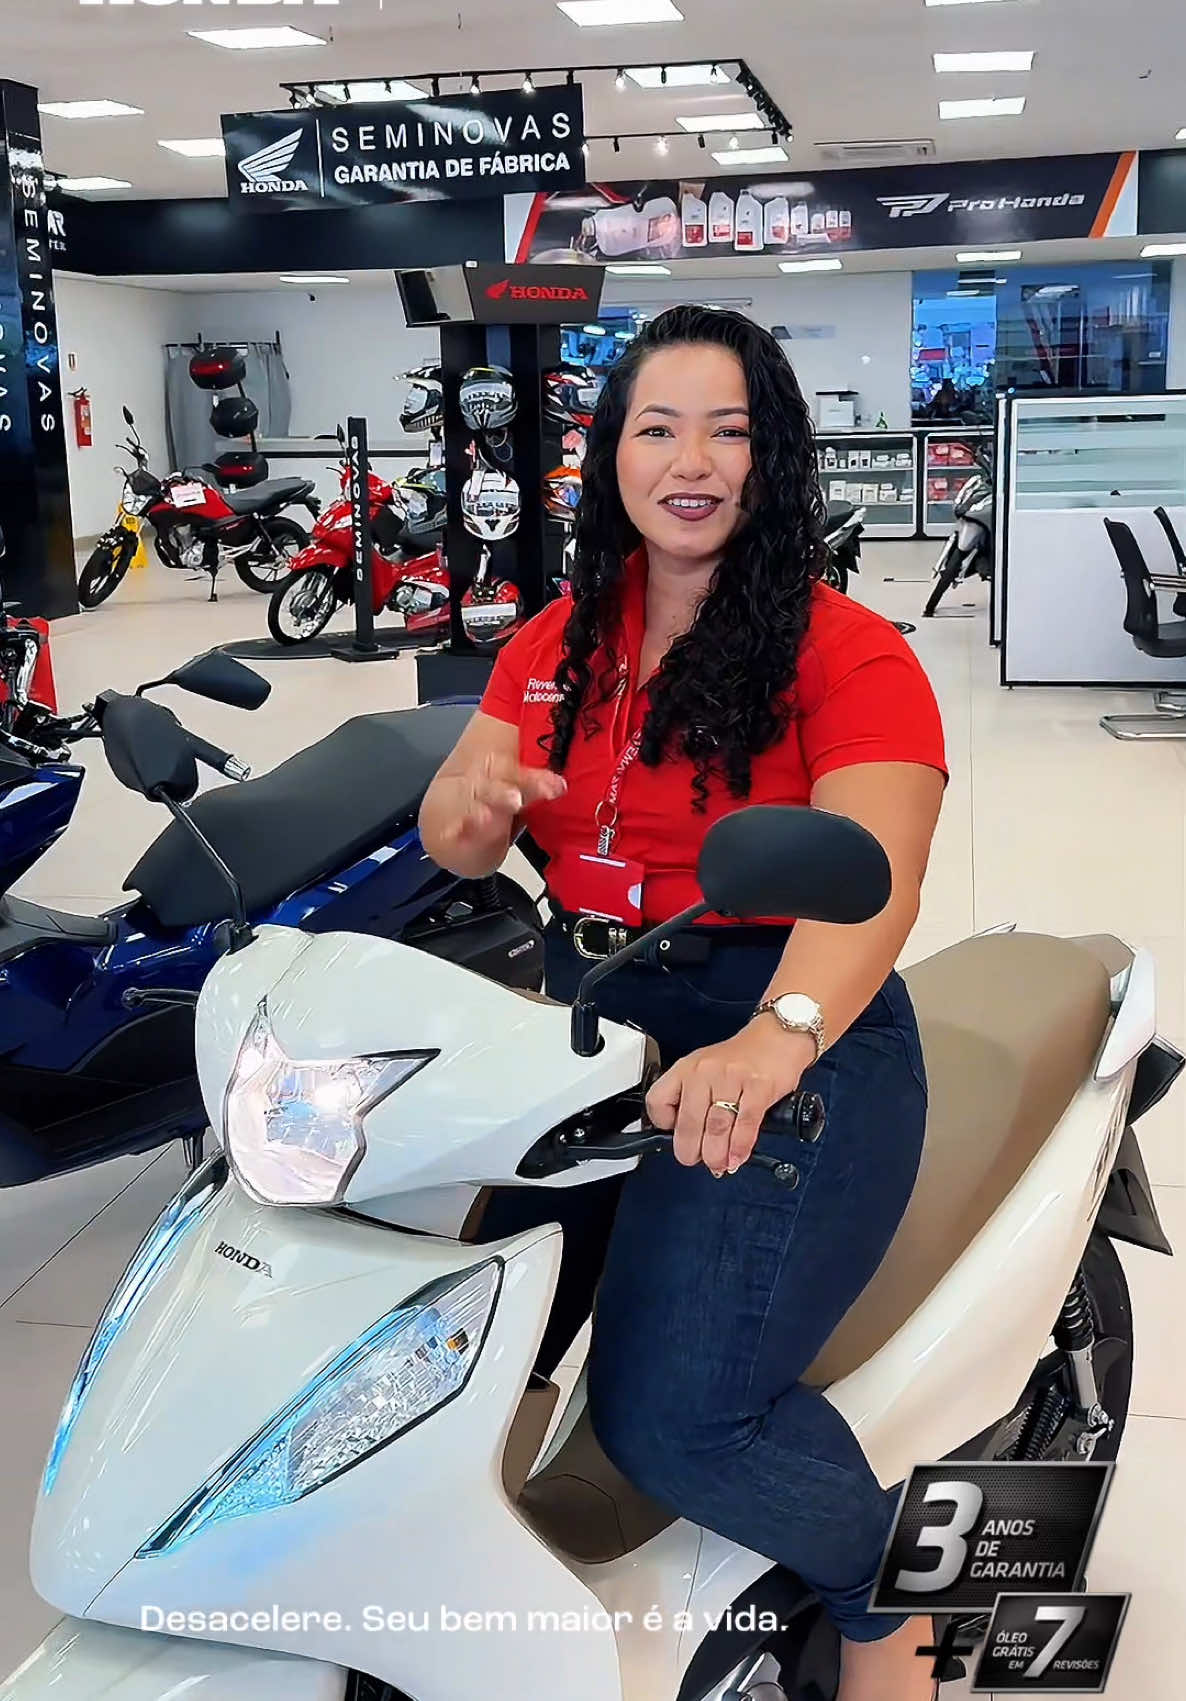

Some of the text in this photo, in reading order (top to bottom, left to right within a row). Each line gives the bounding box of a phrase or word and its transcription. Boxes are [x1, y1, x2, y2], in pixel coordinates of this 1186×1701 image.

[332, 112, 571, 152] SEMINOVAS
[240, 181, 309, 194] HONDA
[334, 152, 570, 184] GARANTIA DE FÁBRICA
[22, 176, 55, 431] SEMINOVAS
[510, 286, 589, 300] HONDA
[351, 436, 363, 581] SEMINOVAS
[214, 1240, 273, 1279] HONDA
